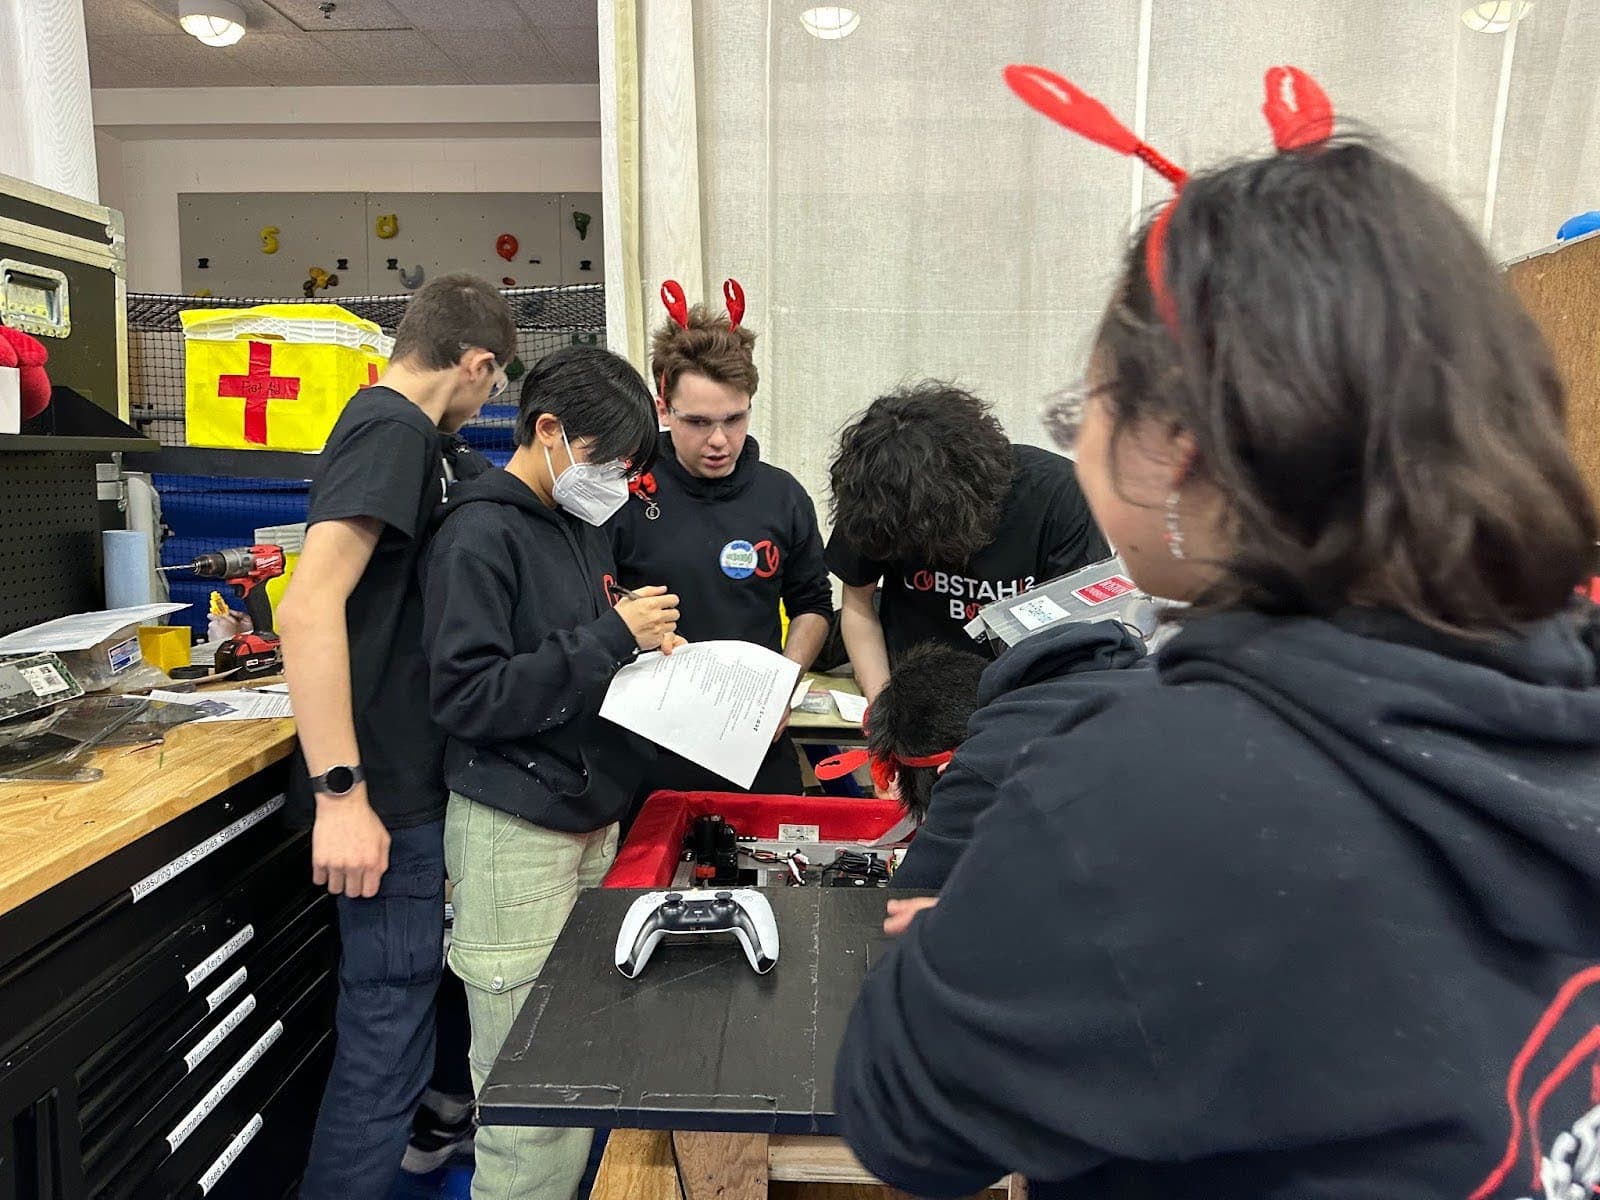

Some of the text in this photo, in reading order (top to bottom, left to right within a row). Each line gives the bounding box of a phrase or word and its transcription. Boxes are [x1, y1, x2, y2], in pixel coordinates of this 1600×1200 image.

[133, 868, 172, 898] Measuring
[189, 1034, 220, 1067] Wrenches
[203, 1091, 220, 1113] Rivet
[203, 1166, 222, 1189] Vises
